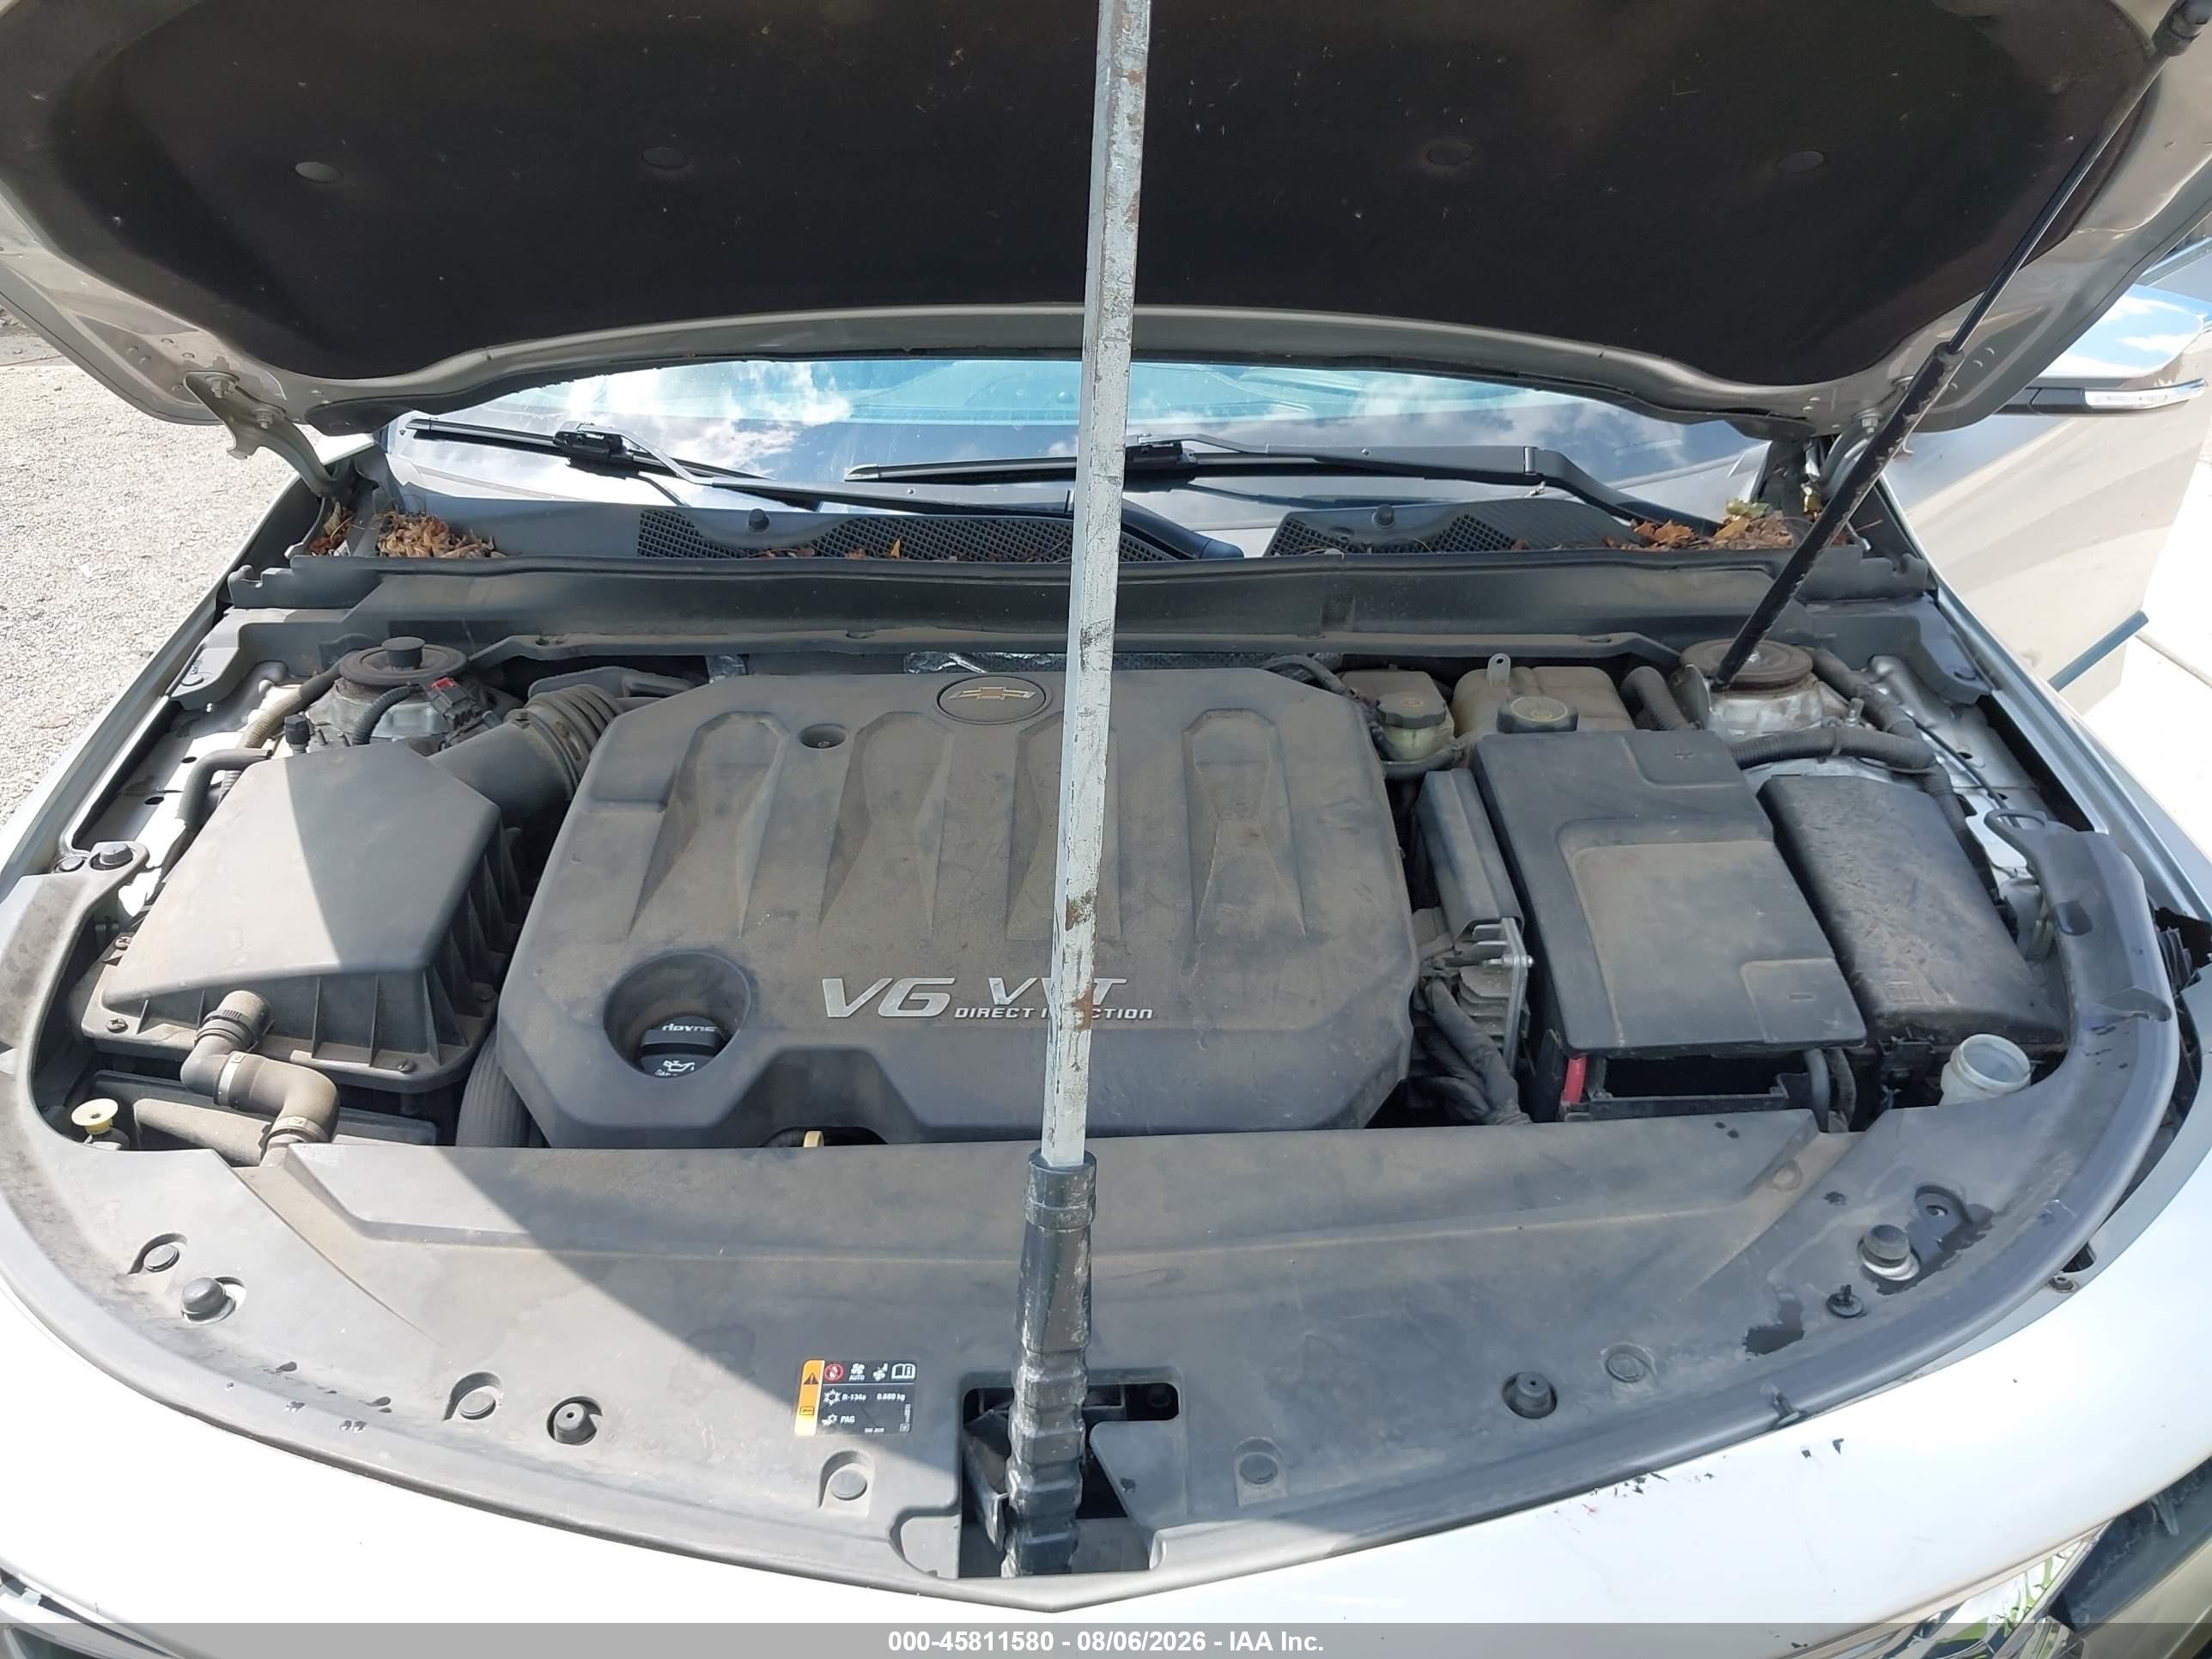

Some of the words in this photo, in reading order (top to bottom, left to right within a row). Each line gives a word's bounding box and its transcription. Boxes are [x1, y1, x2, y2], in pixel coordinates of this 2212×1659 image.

[822, 977, 956, 1018] V6
[988, 977, 1127, 1006] VT
[955, 1007, 1035, 1018] DIRECT
[1042, 1007, 1153, 1019] ICTION
[842, 1393, 866, 1401] R-134a
[840, 1415, 855, 1424] PAG
